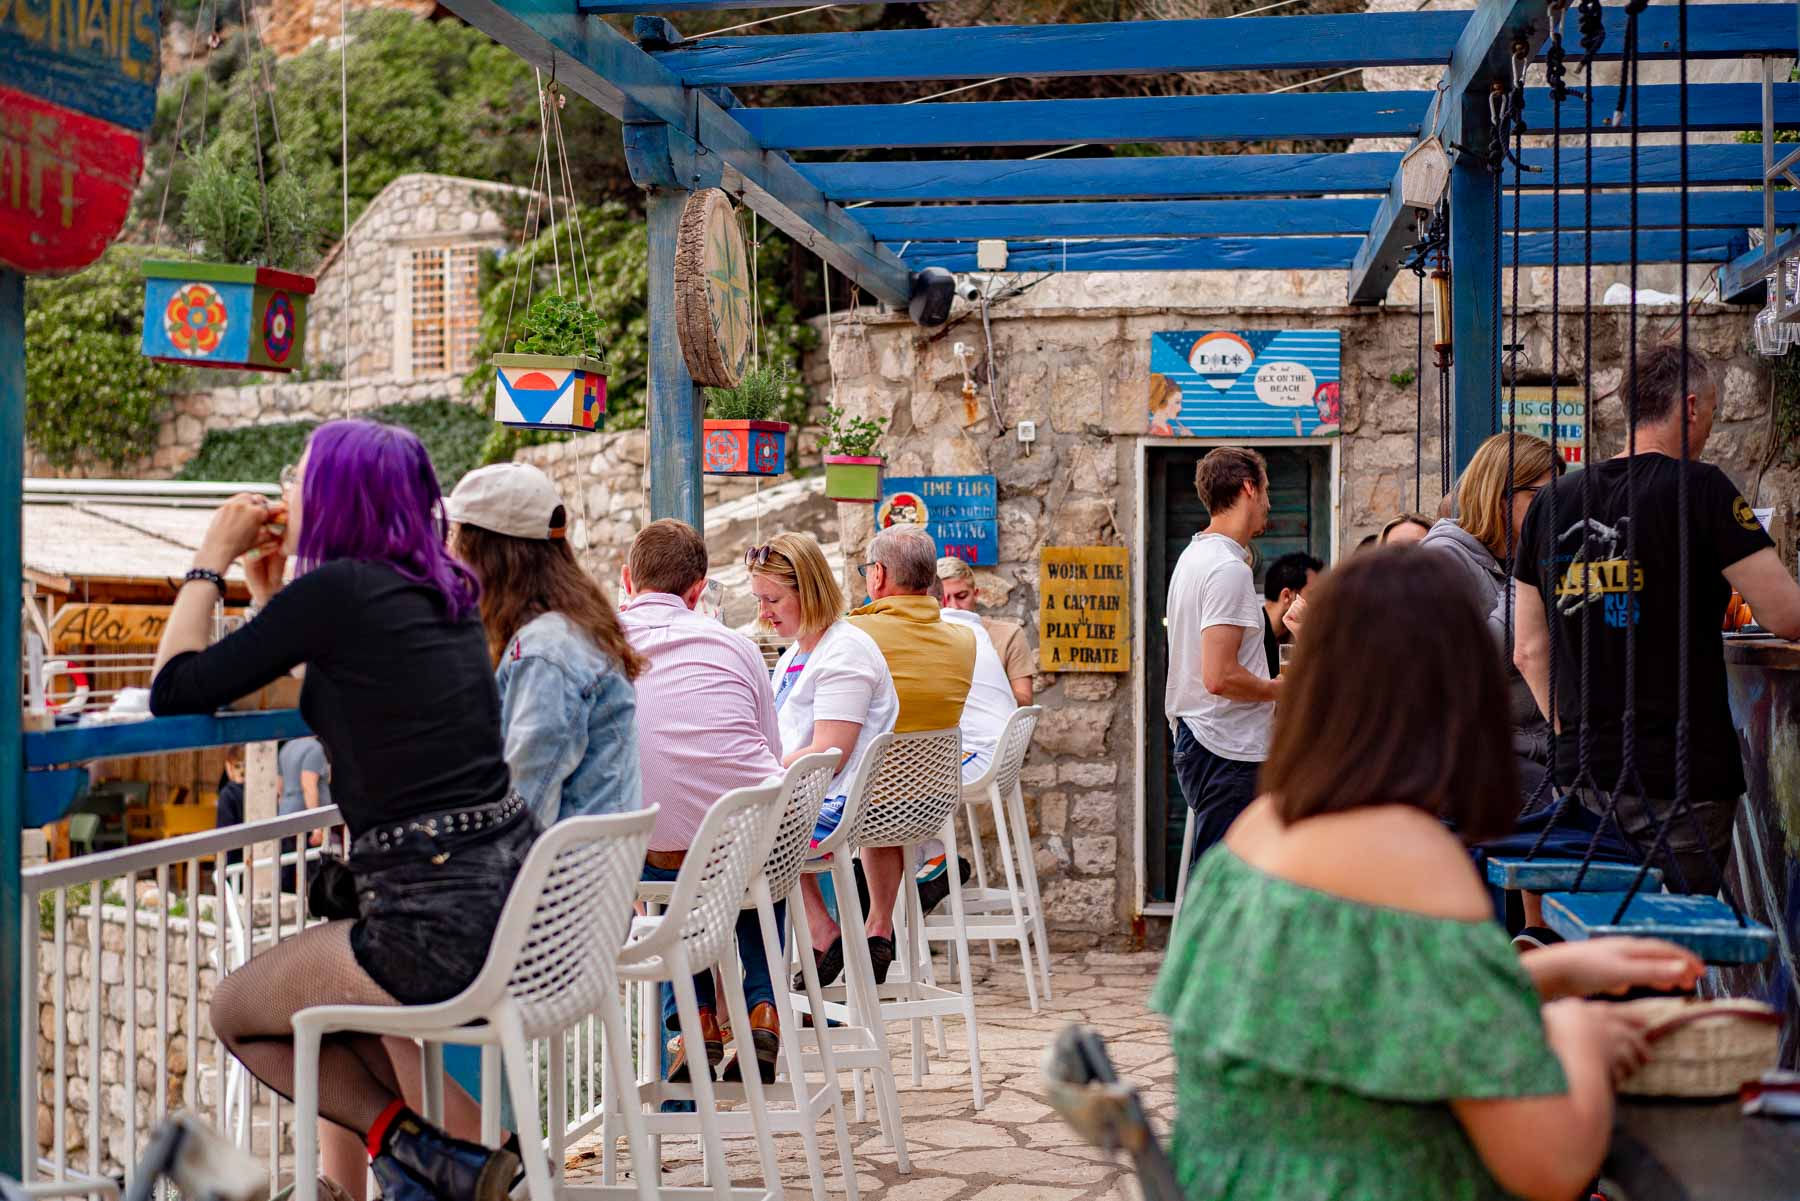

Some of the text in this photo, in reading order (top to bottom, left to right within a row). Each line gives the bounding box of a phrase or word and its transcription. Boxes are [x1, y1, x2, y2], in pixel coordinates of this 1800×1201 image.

[1521, 403, 1533, 416] IS
[1539, 402, 1585, 416] GOOD
[923, 481, 991, 496] TIME FLIES
[1048, 564, 1123, 579] WORK LIKE
[1046, 594, 1120, 610] A CAPTAIN
[58, 607, 130, 641] Ala
[1046, 623, 1116, 640] PLAY LIKE
[1052, 647, 1119, 664] A PIRATE
